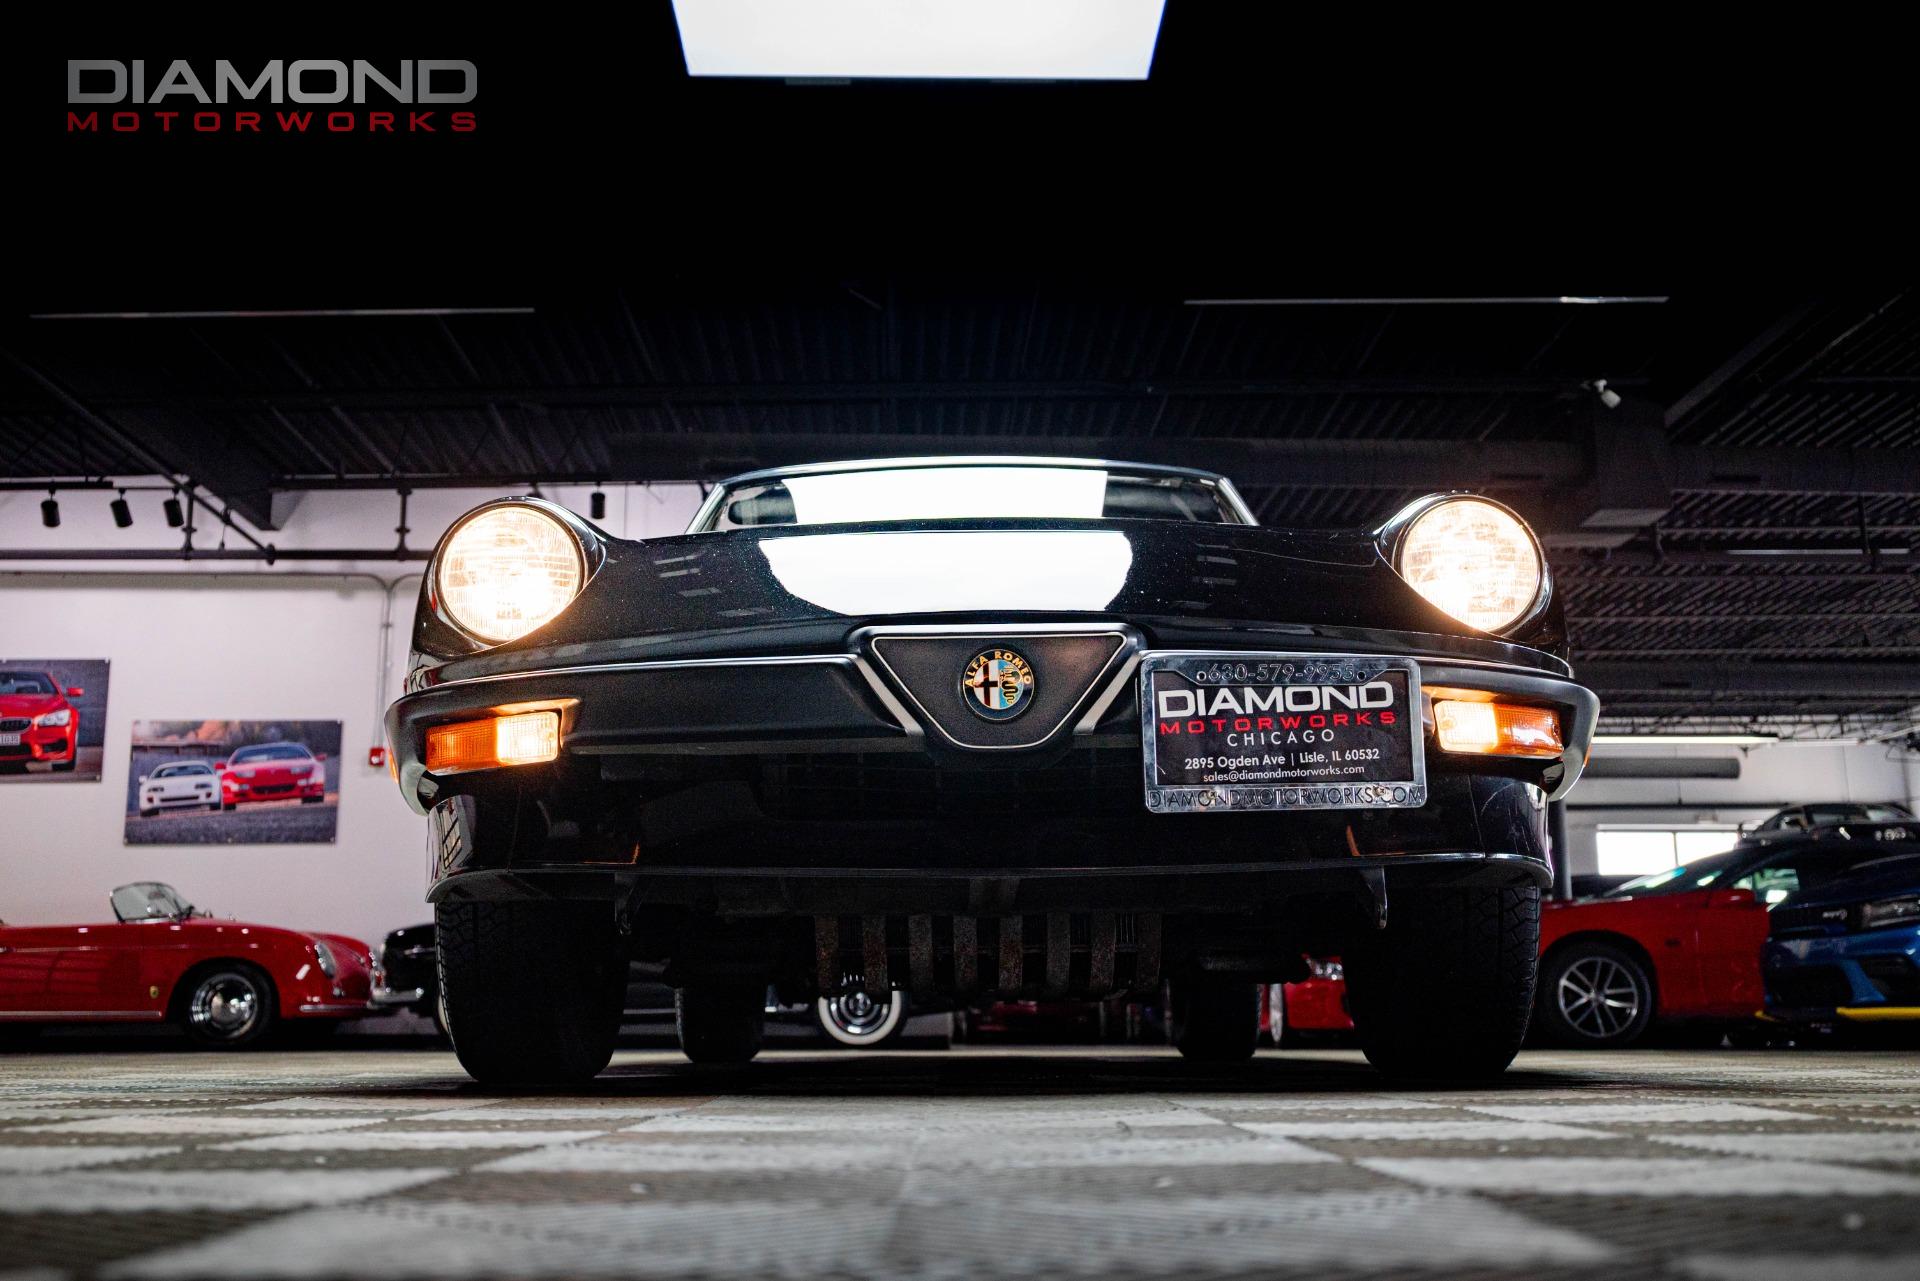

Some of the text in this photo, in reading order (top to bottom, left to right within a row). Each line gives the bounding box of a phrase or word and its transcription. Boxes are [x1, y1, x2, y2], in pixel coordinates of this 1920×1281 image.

[964, 651, 1032, 687] ALFA ROMEO
[1208, 663, 1355, 682] 630-579-9955
[1158, 681, 1394, 718] DIAMOND
[1160, 711, 1397, 735] MOTORWORKS
[1227, 729, 1335, 747] CHICAGO
[1185, 757, 1214, 770] 2895
[1217, 754, 1259, 769] Ogden
[1262, 753, 1286, 766] Ave
[1299, 751, 1329, 765] Lisle,
[1332, 750, 1342, 762] IL
[1345, 748, 1380, 761] 60532
[1203, 765, 1365, 783] sales@diamondmotorworks.com
